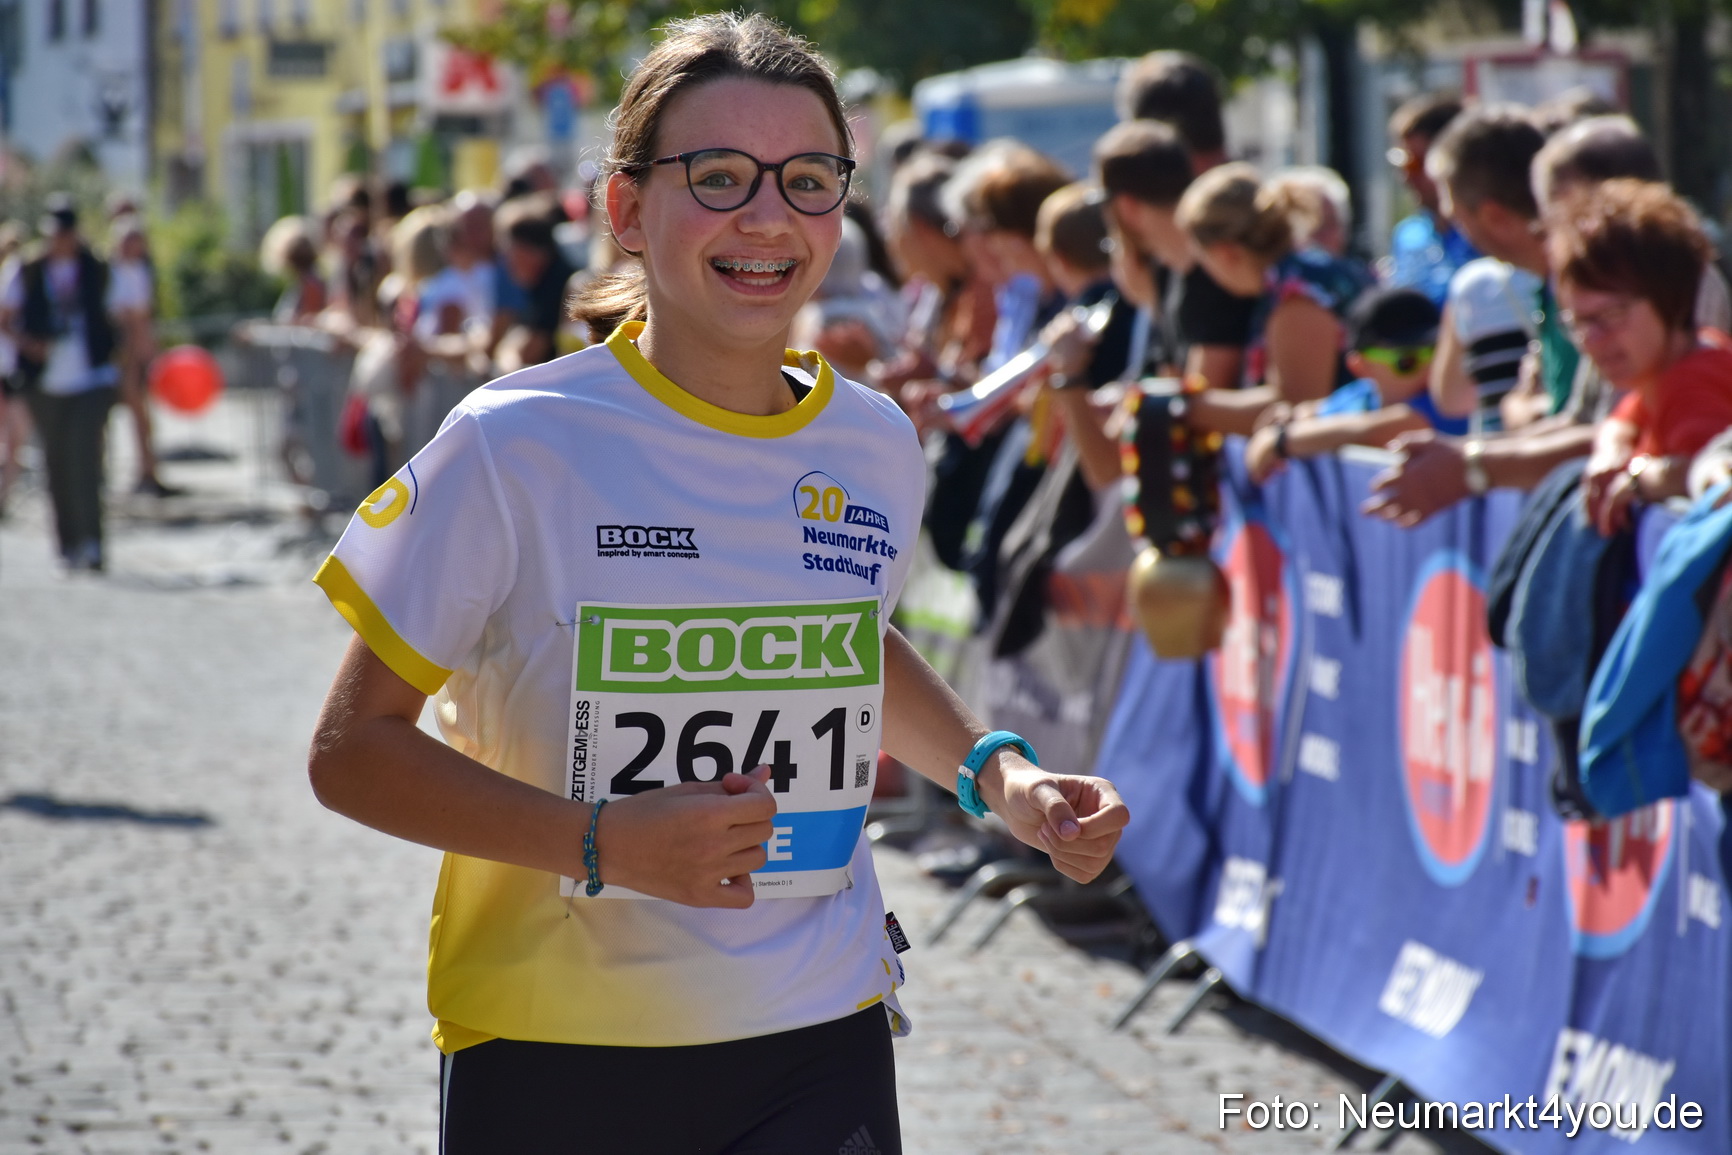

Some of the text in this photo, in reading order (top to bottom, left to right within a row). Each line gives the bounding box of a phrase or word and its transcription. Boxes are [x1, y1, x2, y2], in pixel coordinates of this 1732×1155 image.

[800, 485, 887, 529] 20 JAHRE
[597, 525, 698, 550] BOCK
[632, 550, 641, 558] by
[667, 551, 700, 559] concepts
[803, 526, 897, 562] Neumarkter
[803, 553, 881, 585] Stadtlauf
[602, 613, 865, 682] BOCK
[592, 700, 600, 749] ZEITMESSUNG
[861, 710, 870, 726] D
[610, 707, 847, 794] 2641
